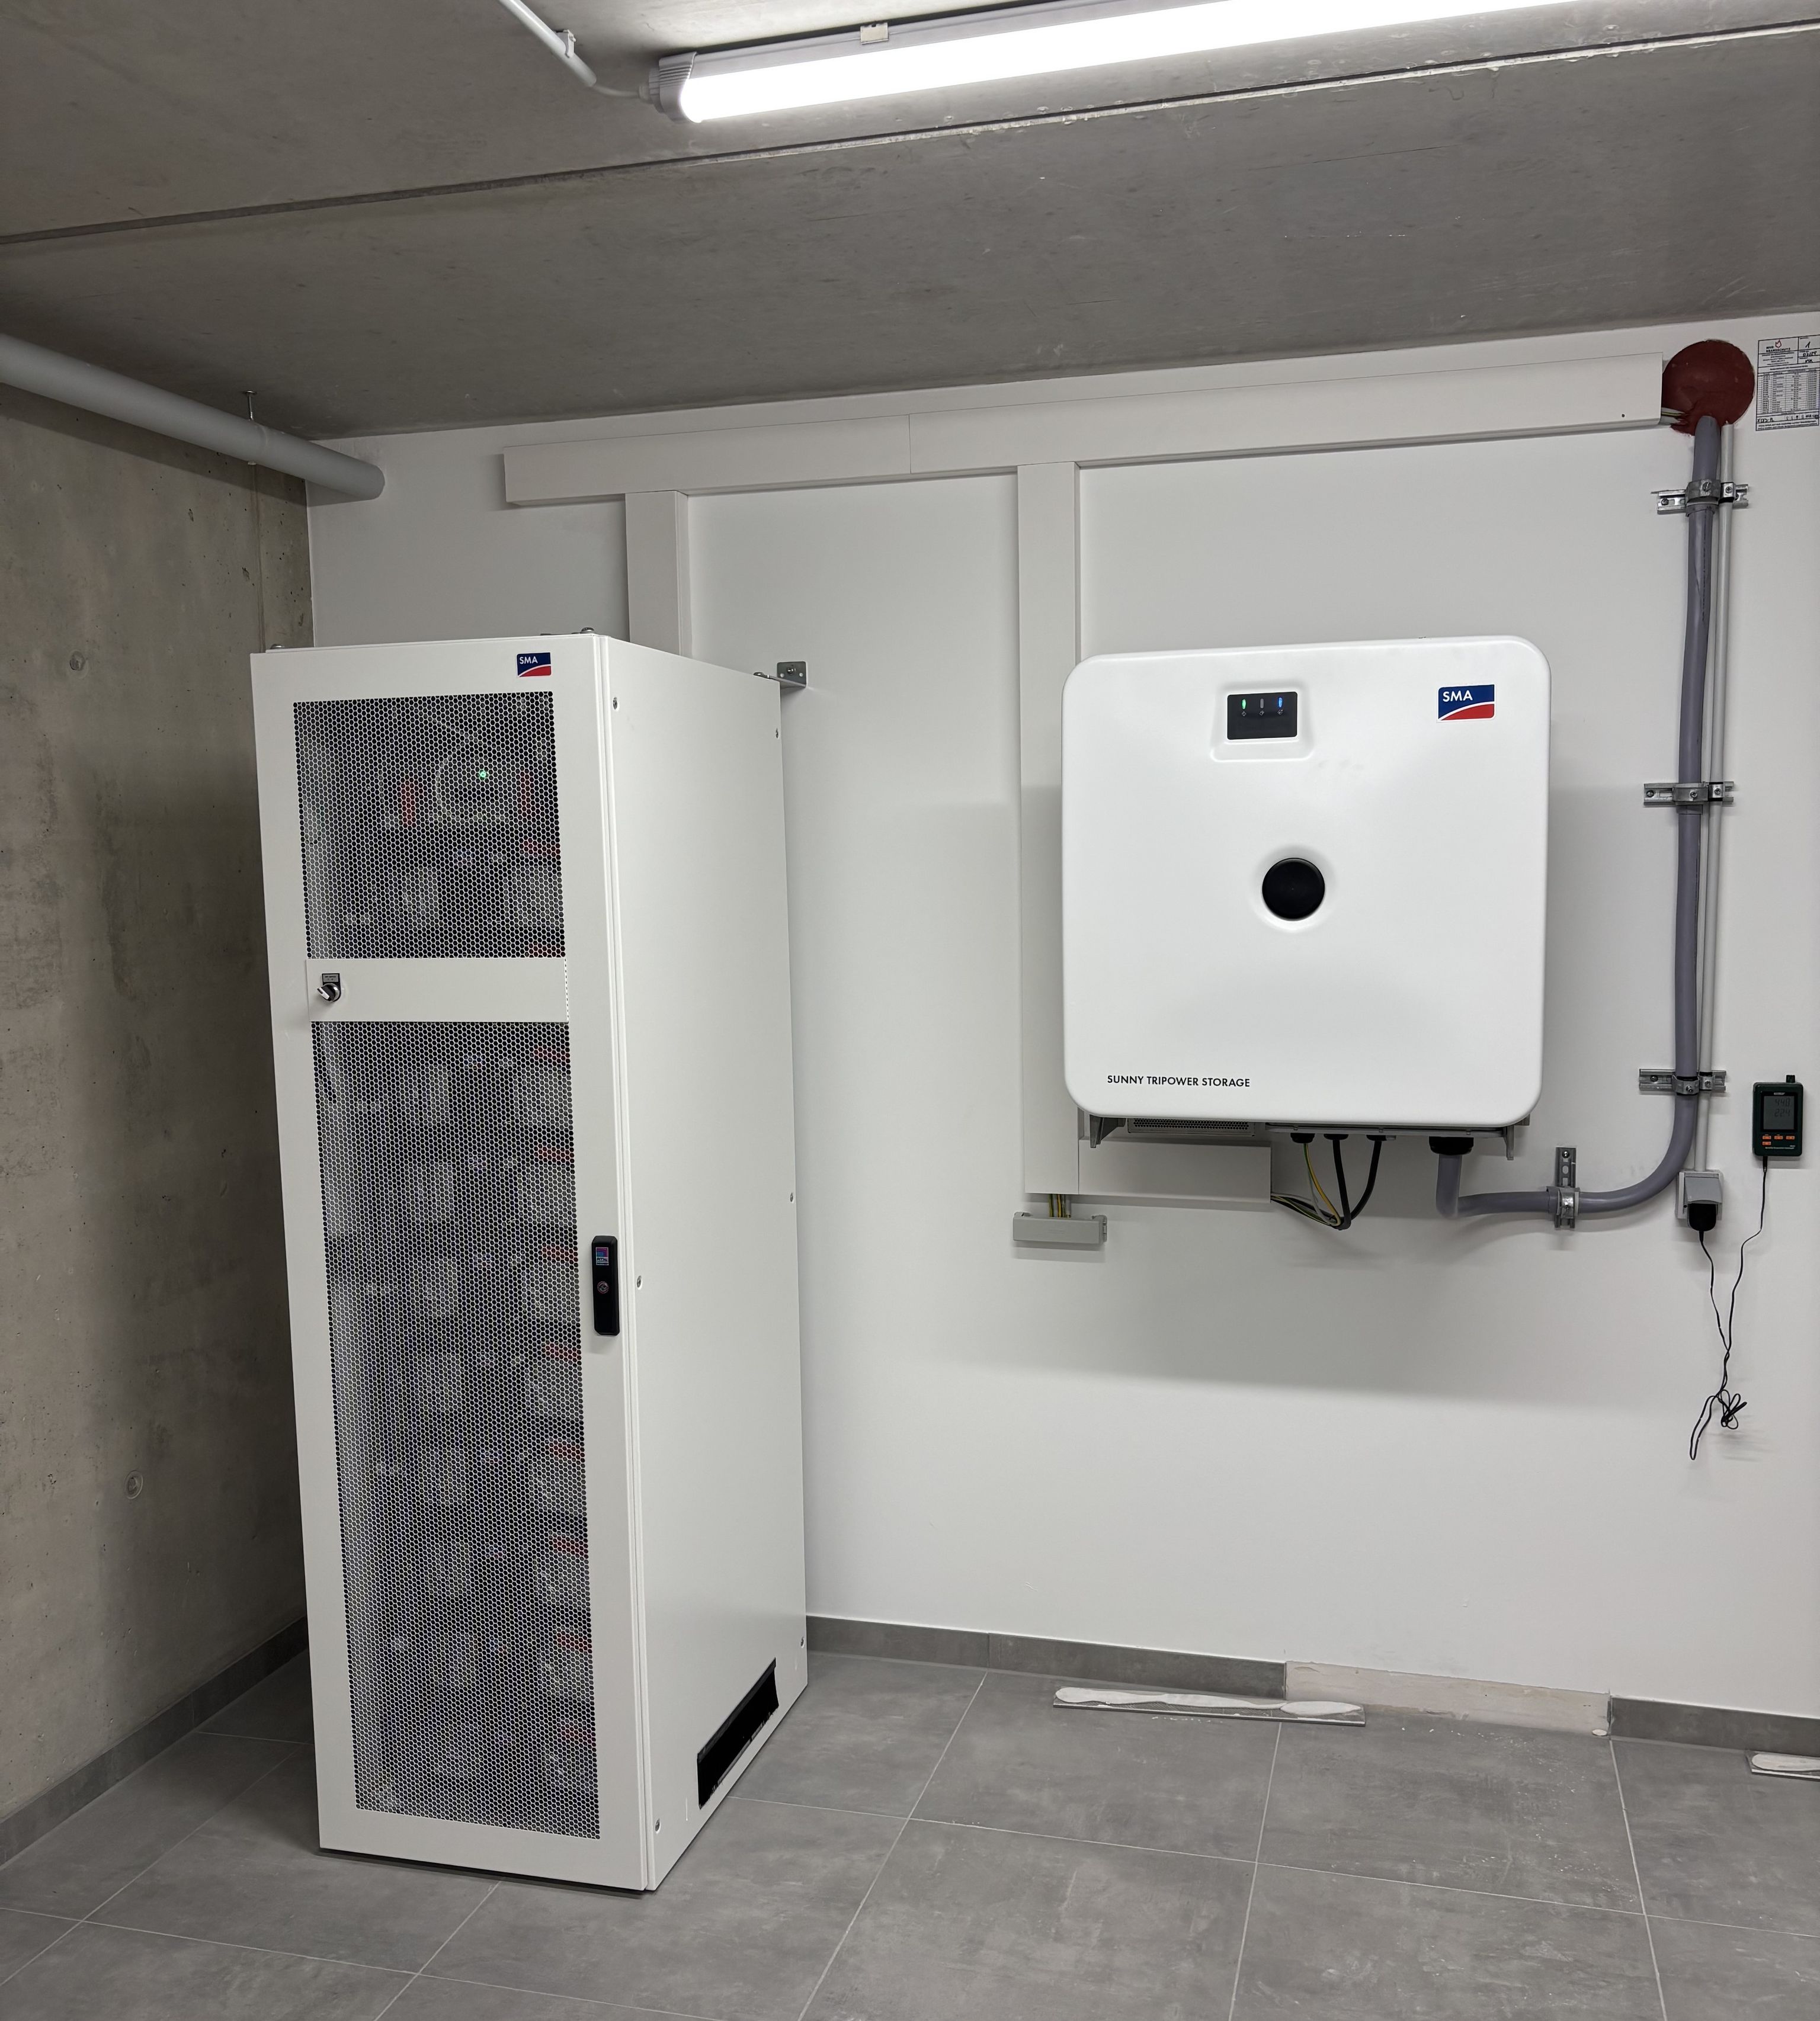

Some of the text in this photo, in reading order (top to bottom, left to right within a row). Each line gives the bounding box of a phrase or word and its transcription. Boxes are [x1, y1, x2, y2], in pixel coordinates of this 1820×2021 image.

[1443, 690, 1473, 702] SMA
[1107, 1075, 1250, 1087] SUNNY TRIPOWER STORAGE
